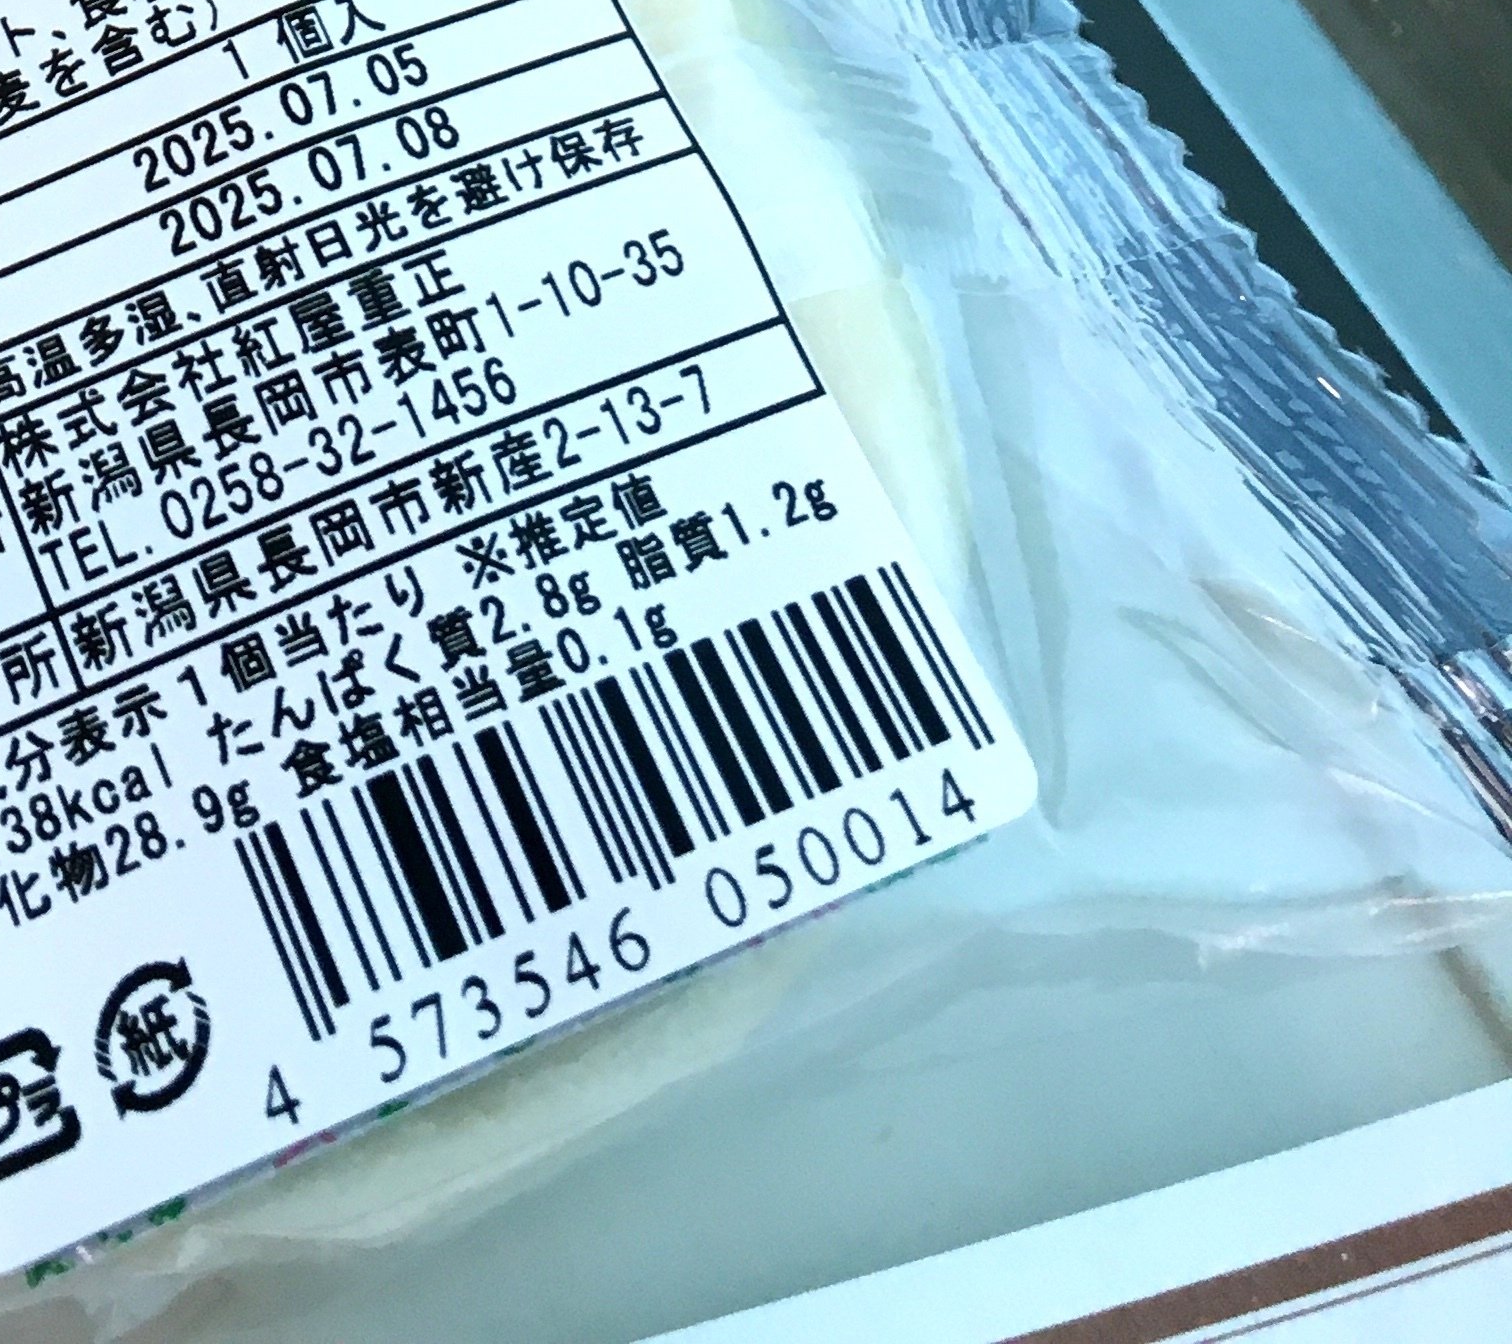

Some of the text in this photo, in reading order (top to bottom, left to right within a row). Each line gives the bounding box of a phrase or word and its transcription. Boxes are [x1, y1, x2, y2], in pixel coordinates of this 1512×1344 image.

[133, 43, 429, 194] 2025.07.05
[159, 106, 460, 257] 2025.07.08
[18, 229, 684, 537] 新潟県長岡市表町1-10-35
[71, 365, 711, 672] 新潟県長岡市新産2-13-7
[209, 572, 602, 765] たんぱく質2.8g
[616, 478, 838, 590] 脂質1.2g
[283, 603, 680, 798] 食塩相当量0.1g
[118, 994, 188, 1078] 紙
[264, 767, 976, 1126] 4 573546 050014
